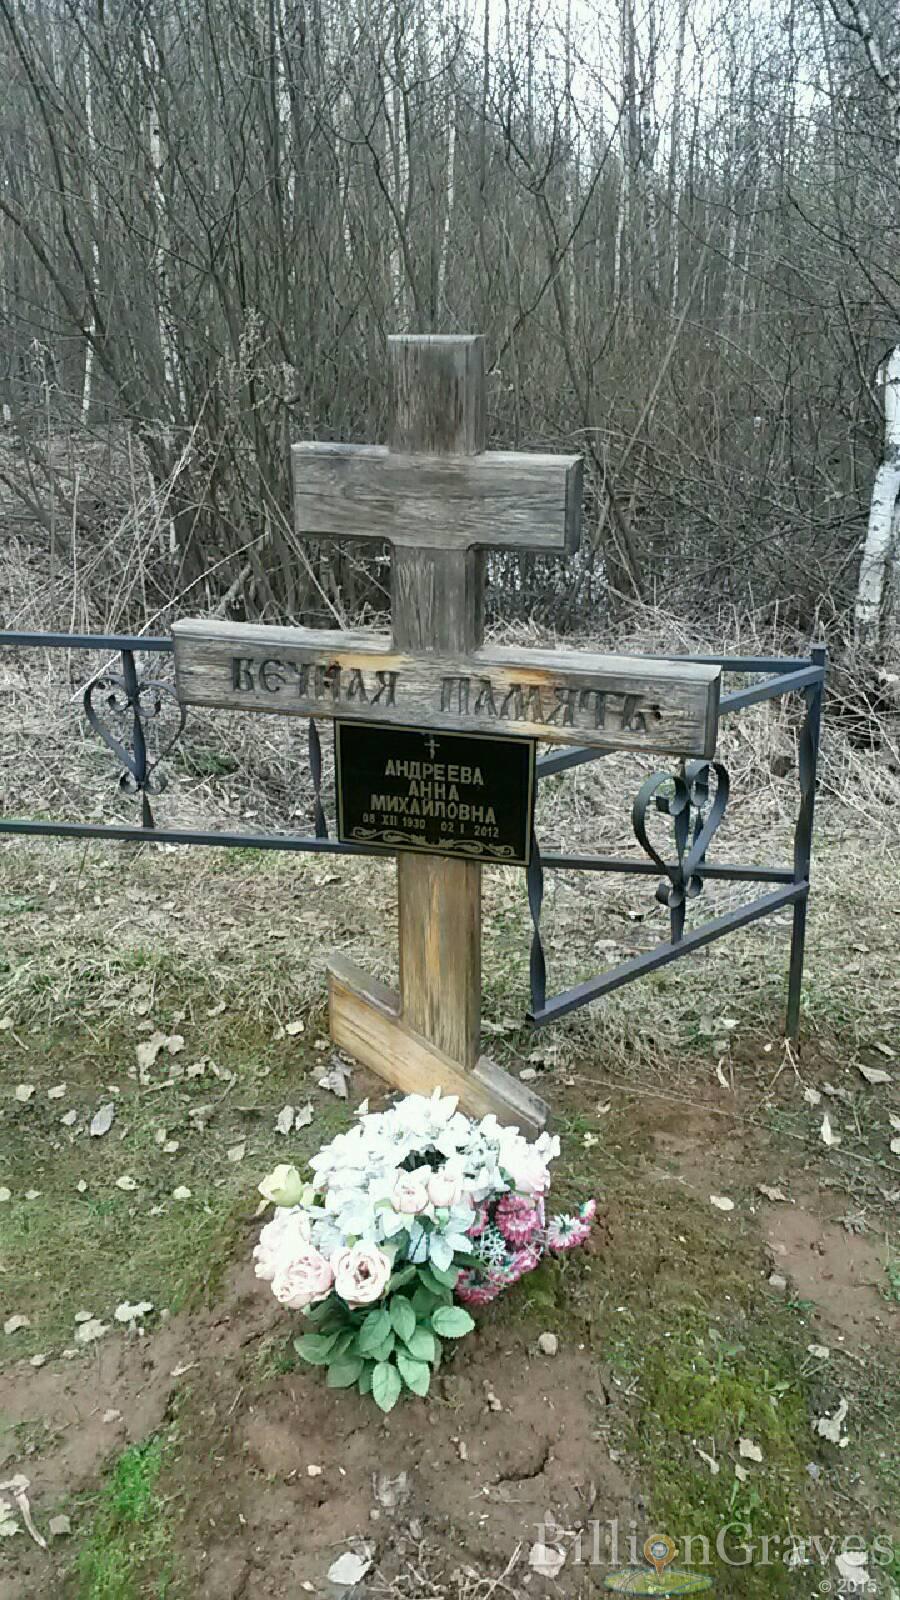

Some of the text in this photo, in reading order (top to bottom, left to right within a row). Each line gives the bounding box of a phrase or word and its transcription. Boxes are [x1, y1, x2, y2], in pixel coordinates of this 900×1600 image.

[440, 676, 648, 733] ПАМЯТЬ
[385, 759, 484, 786] АНДРЕЕВА
[408, 780, 460, 801] АННА
[370, 794, 497, 825] МИХАЙЛОВНА
[474, 825, 500, 838] 2012
